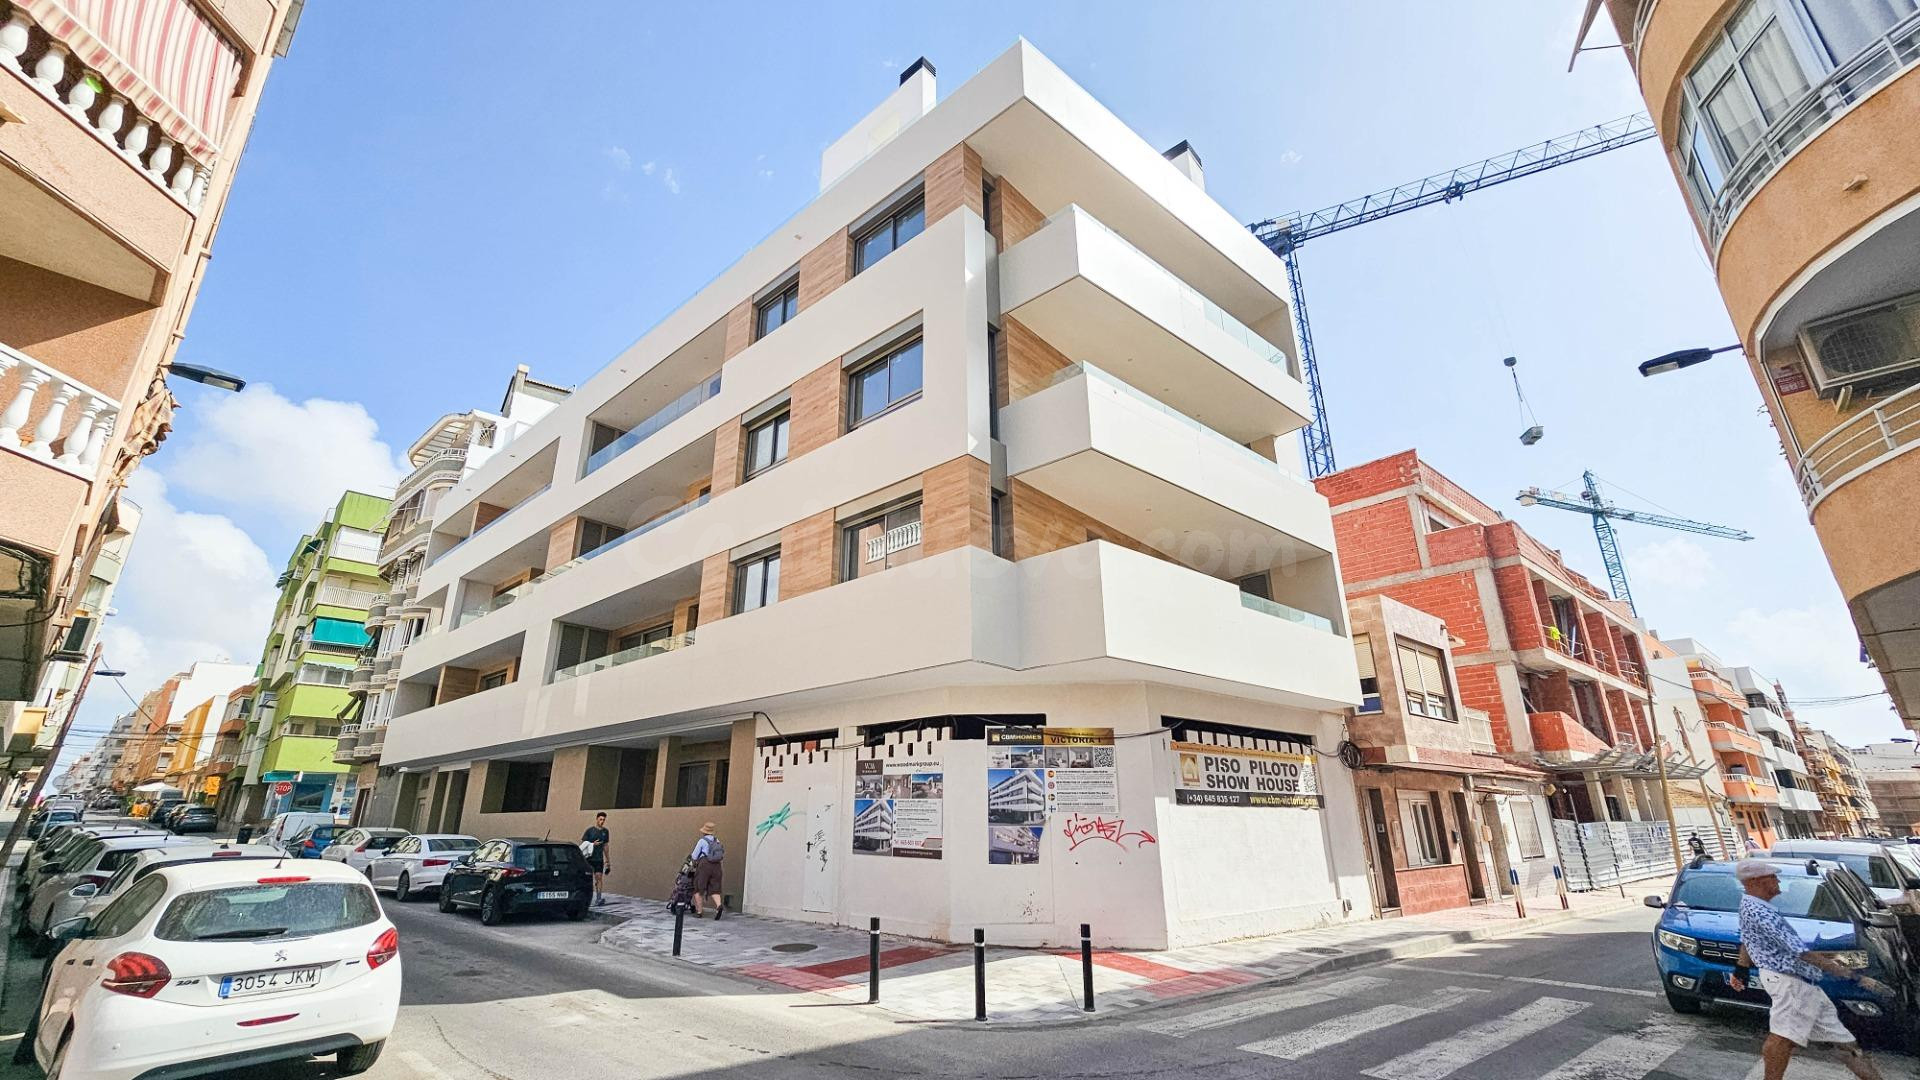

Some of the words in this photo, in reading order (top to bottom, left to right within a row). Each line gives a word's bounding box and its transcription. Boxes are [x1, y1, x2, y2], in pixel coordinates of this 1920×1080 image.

[1001, 733, 1041, 741] CBMHOMES
[1051, 736, 1095, 744] VICTORIA
[1204, 756, 1241, 774] PISO
[1249, 760, 1298, 777] PILOTO
[275, 785, 292, 793] STOP
[1206, 774, 1249, 790] SHOW
[1257, 777, 1300, 793] HOUSE
[233, 973, 278, 992] 3054
[285, 969, 316, 985] JKM
